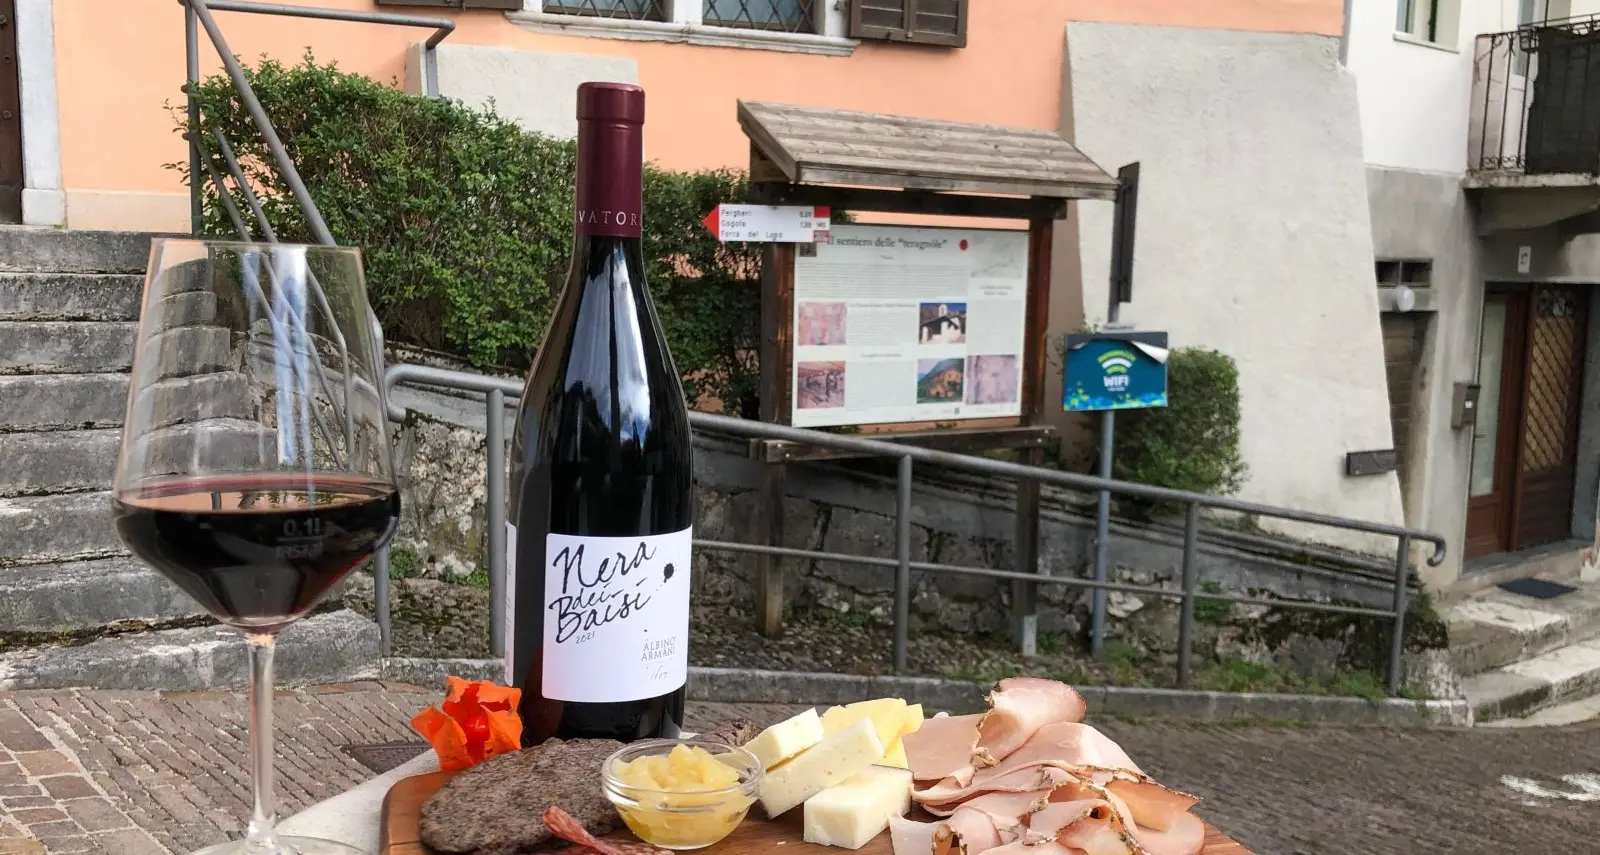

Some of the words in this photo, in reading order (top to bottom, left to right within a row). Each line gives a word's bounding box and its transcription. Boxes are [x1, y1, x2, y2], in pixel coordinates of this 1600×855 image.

[747, 229, 759, 238] del
[836, 237, 872, 246] sentiero
[875, 236, 896, 248] delle
[553, 542, 656, 594] Nera
[576, 631, 596, 644] 2021
[642, 636, 676, 652] ALBINO
[641, 645, 675, 658] ARMANI
